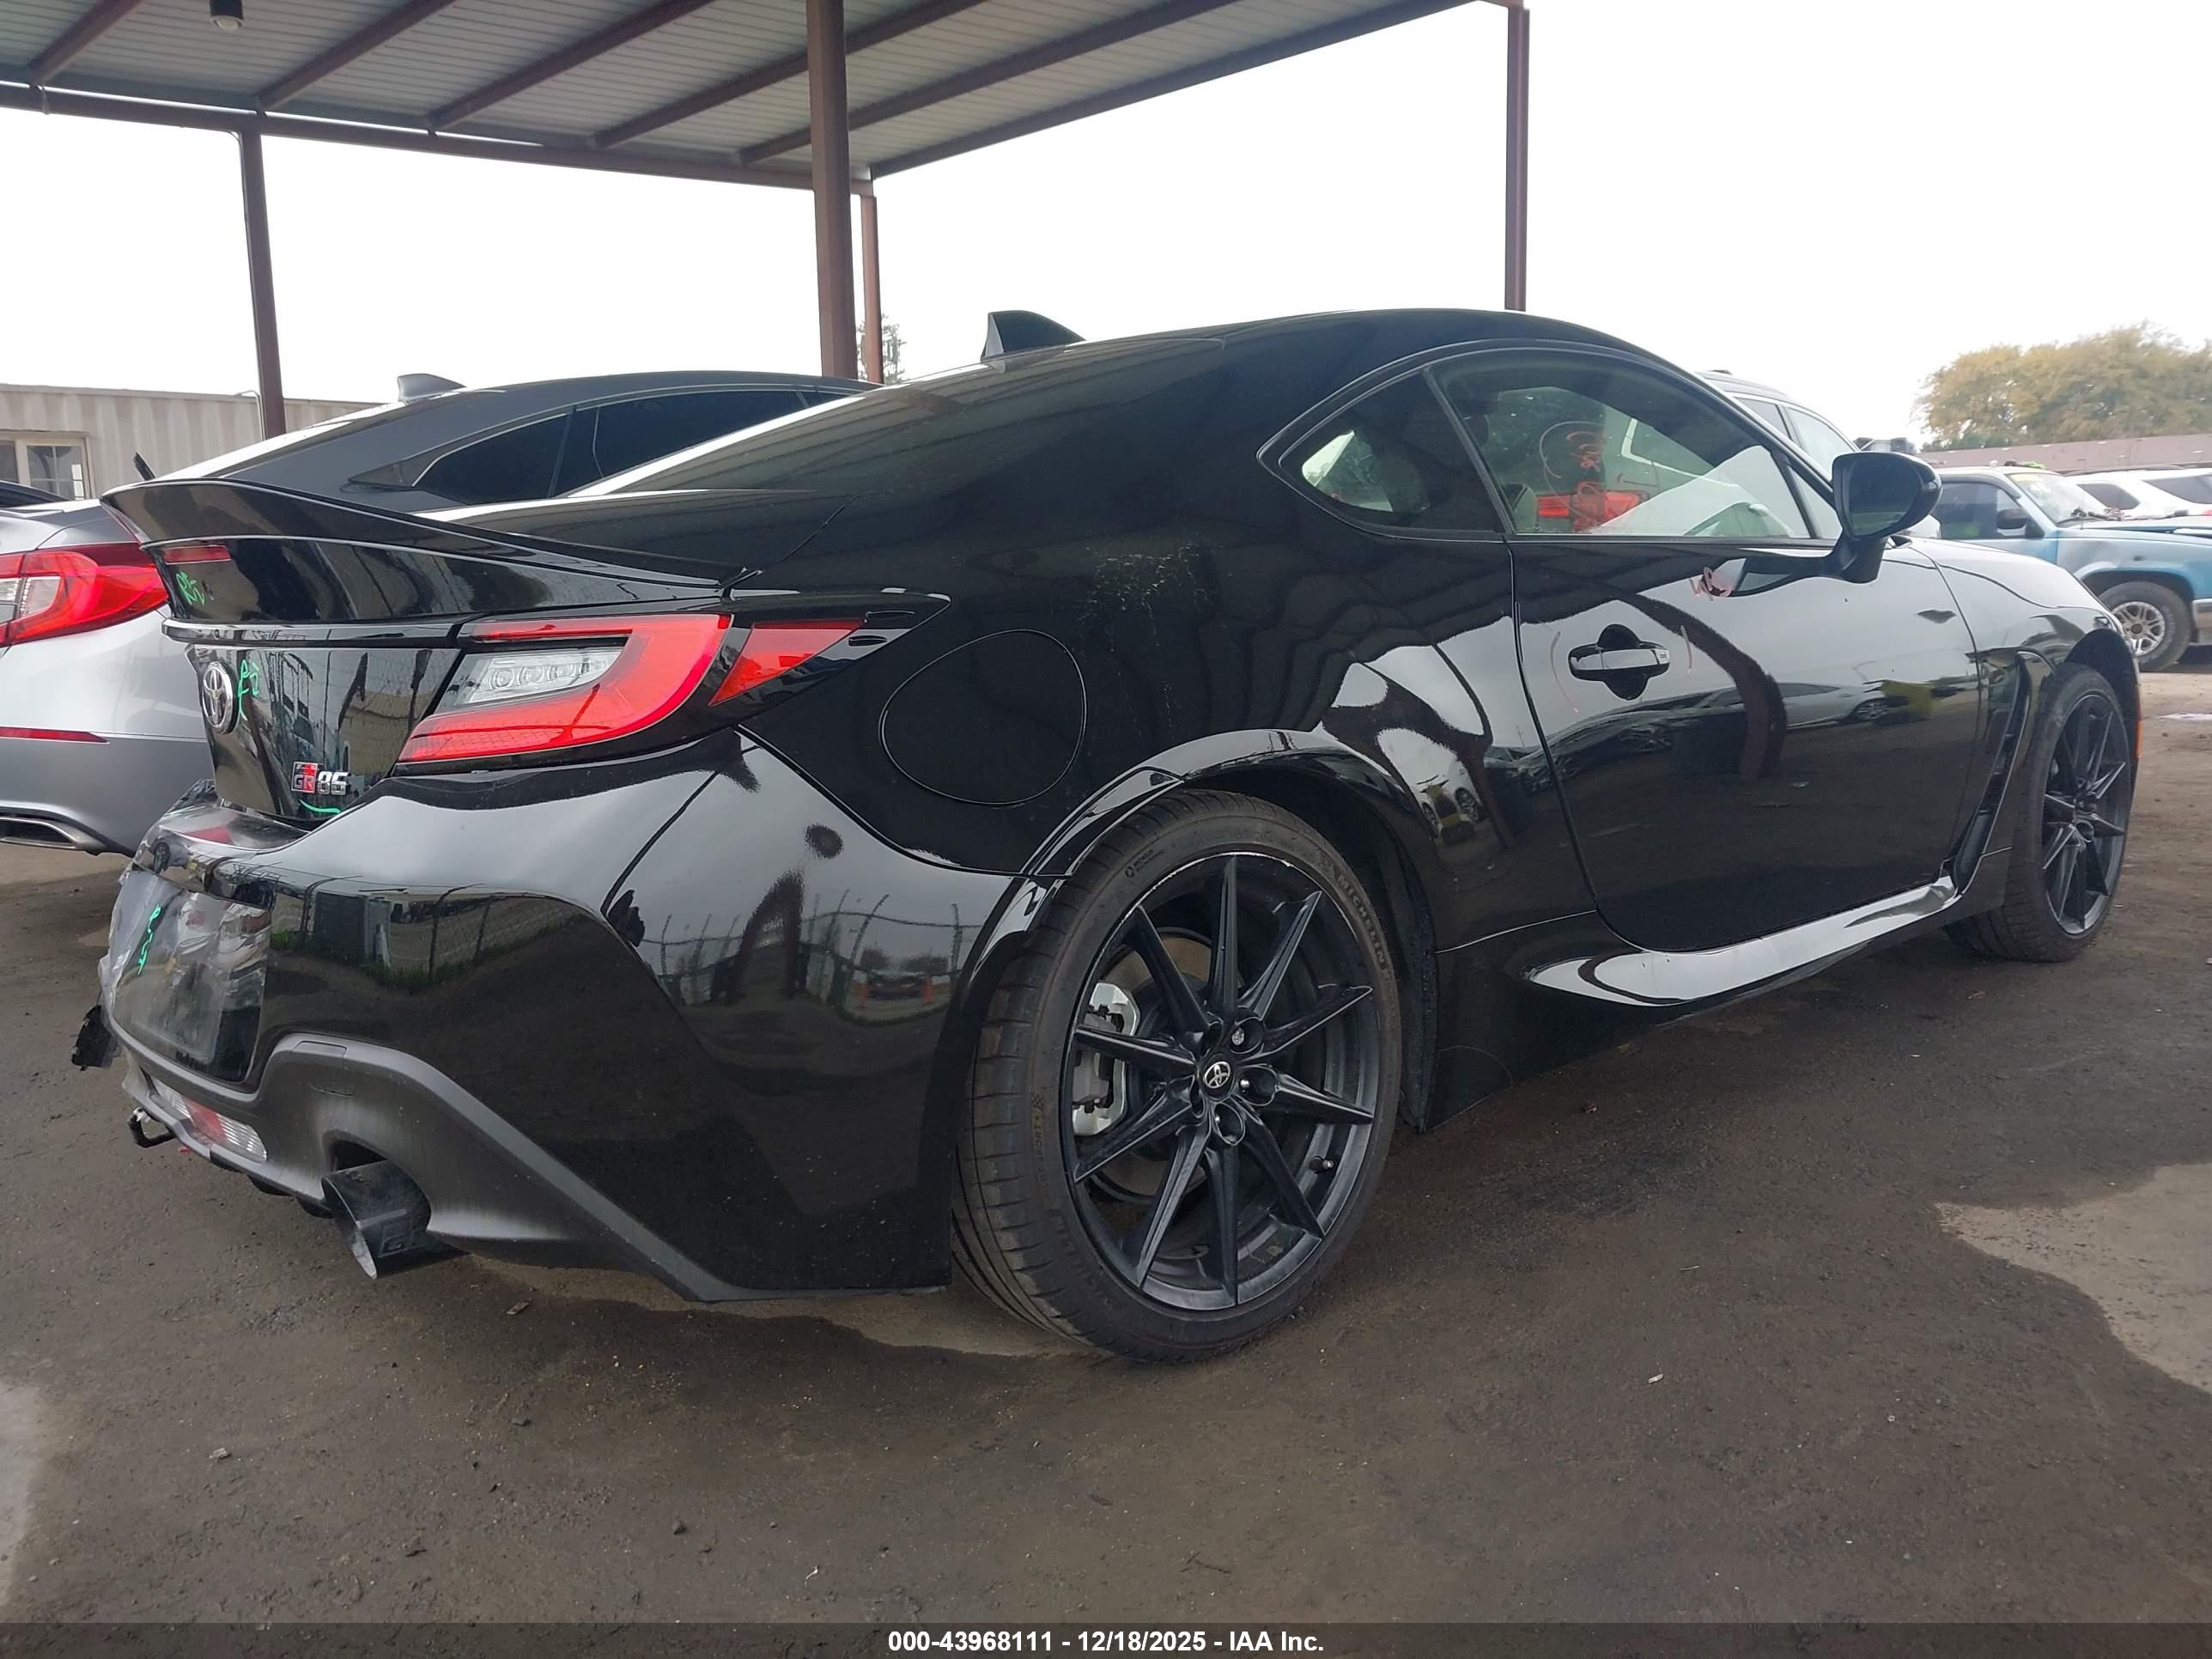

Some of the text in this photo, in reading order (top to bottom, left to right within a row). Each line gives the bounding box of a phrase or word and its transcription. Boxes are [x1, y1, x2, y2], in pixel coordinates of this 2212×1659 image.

[294, 771, 348, 795] GR 86
[1337, 872, 1387, 964] MICHELIN
